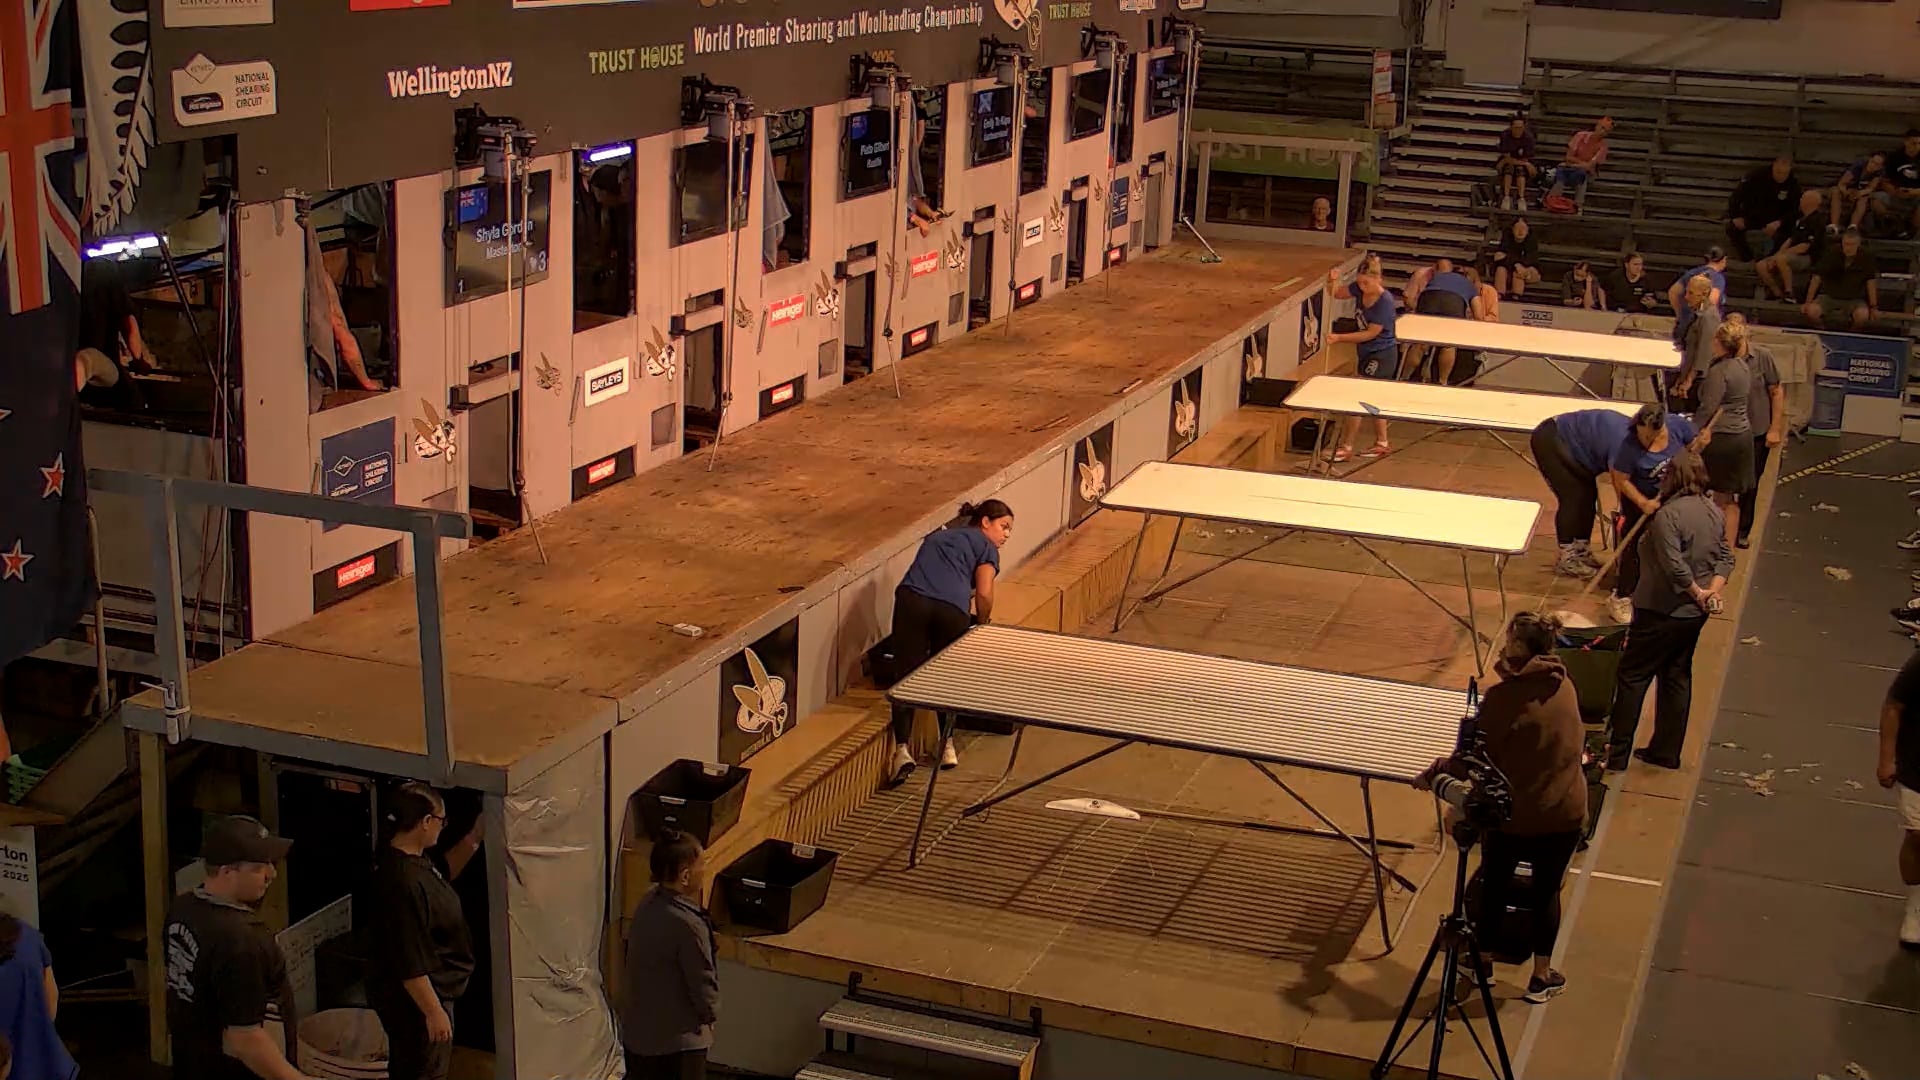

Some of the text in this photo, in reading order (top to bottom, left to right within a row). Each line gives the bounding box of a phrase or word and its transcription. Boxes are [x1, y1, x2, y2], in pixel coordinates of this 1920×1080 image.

[694, 2, 984, 54] World Premier Shearing and Woolhandling Championship
[588, 43, 685, 75] TRUST HOUSE
[235, 71, 270, 85] NATIONAL
[387, 61, 513, 98] WellingtonNZ
[235, 83, 271, 97] SHEARING
[236, 97, 263, 109] CIRCUIT
[476, 219, 534, 243] Shyla Gordn
[1521, 310, 1553, 321] NOTICE
